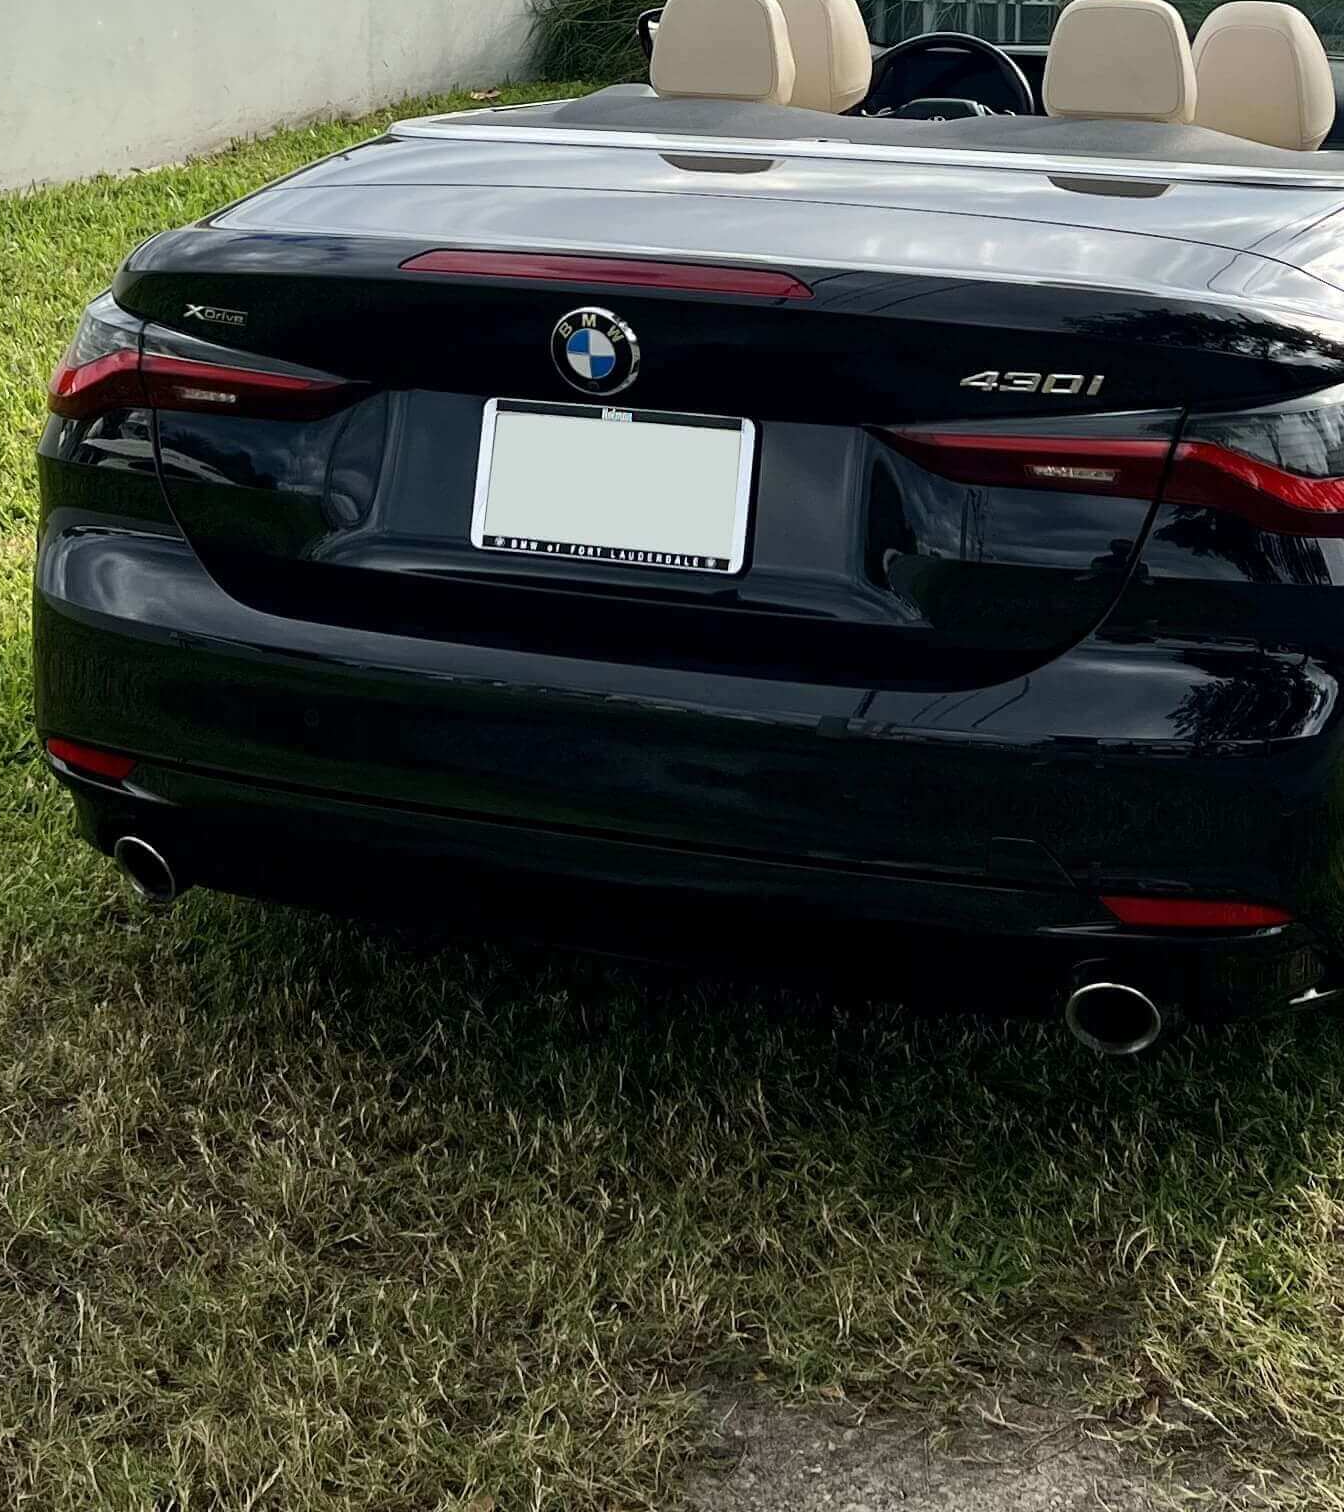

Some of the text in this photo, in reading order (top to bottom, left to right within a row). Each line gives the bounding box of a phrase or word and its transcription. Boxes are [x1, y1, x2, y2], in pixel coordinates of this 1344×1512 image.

[558, 313, 625, 343] BMW
[511, 539, 538, 551] BMW
[570, 545, 601, 557] FORT
[610, 549, 699, 567] LAUDERDALE
